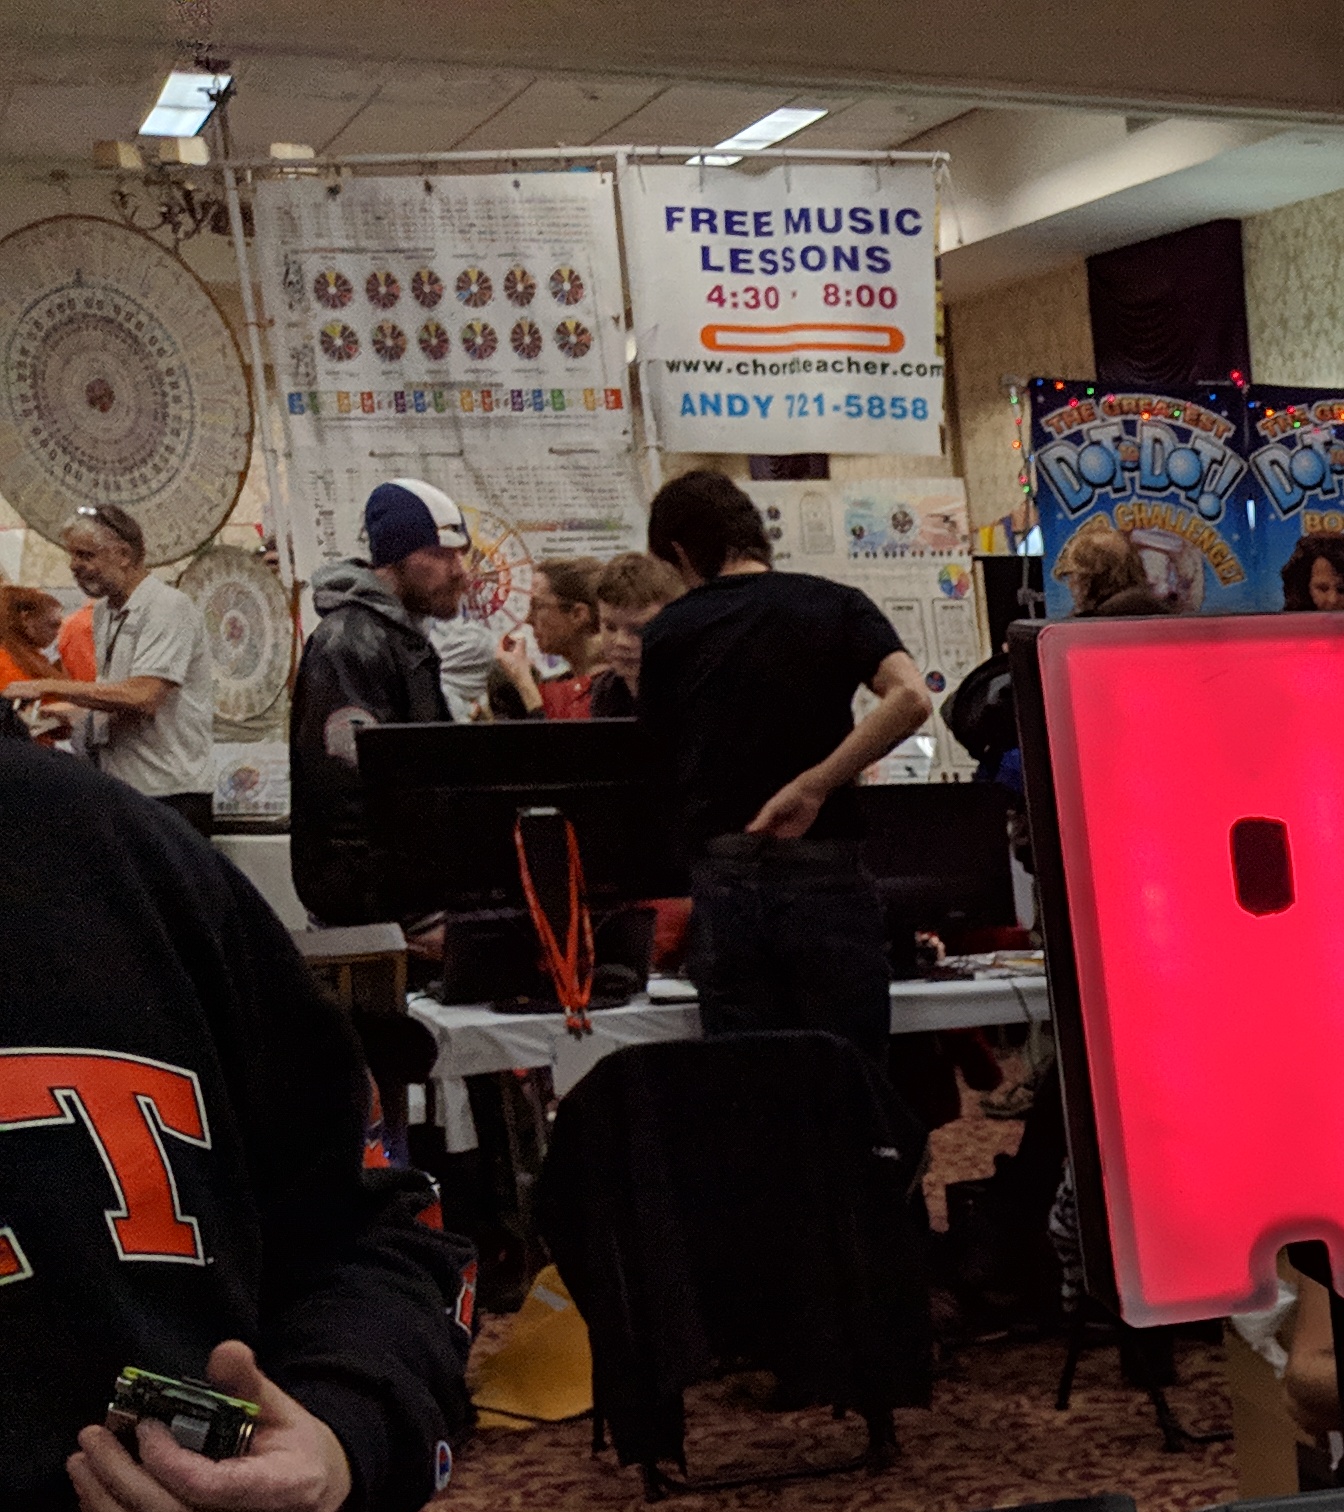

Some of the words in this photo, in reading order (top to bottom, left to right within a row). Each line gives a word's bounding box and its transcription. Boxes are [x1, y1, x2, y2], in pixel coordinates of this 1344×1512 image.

[665, 206, 774, 237] FREE
[784, 207, 923, 237] MUSIC
[700, 245, 892, 275] LESSONS
[706, 284, 780, 310] 4:30
[823, 284, 898, 309] 8:00
[680, 393, 774, 418] ANDY
[785, 393, 929, 420] 721-5858
